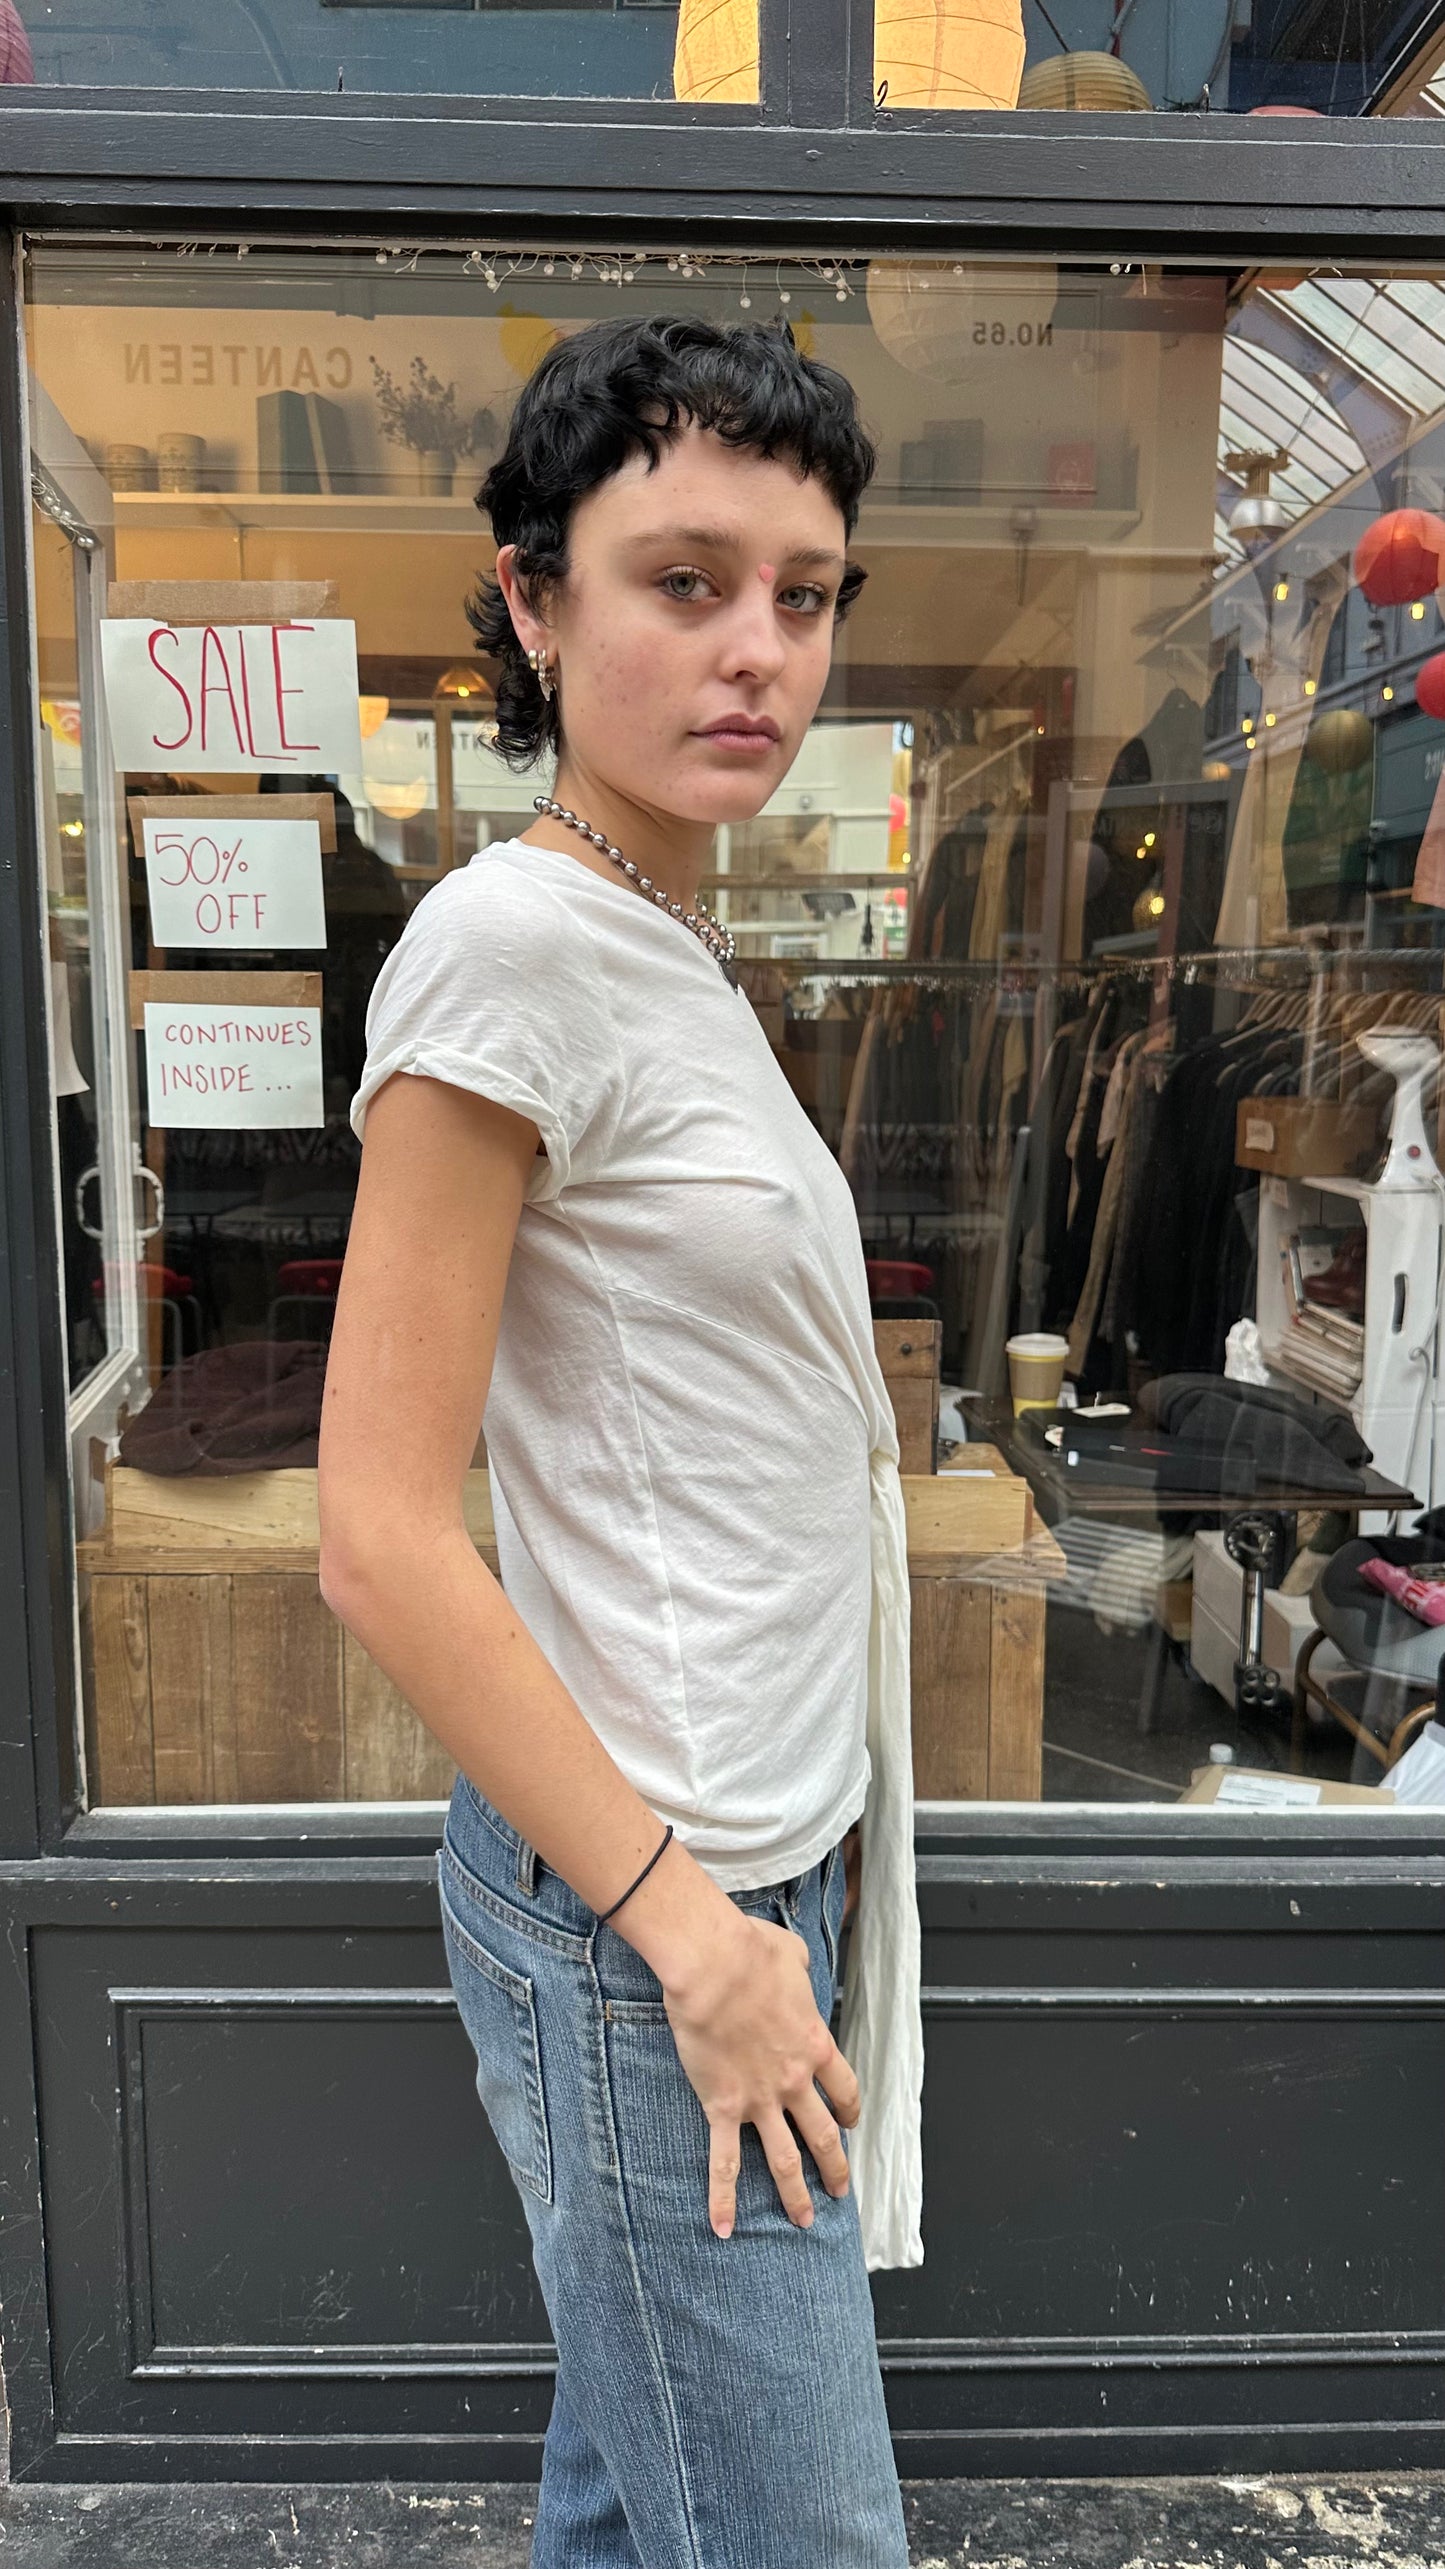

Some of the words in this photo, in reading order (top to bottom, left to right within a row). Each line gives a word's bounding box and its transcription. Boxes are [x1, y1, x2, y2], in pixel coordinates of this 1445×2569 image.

[148, 625, 321, 761] SALE
[154, 834, 249, 886] 50%
[196, 894, 268, 934] OFF
[165, 1020, 312, 1047] CONTINUES
